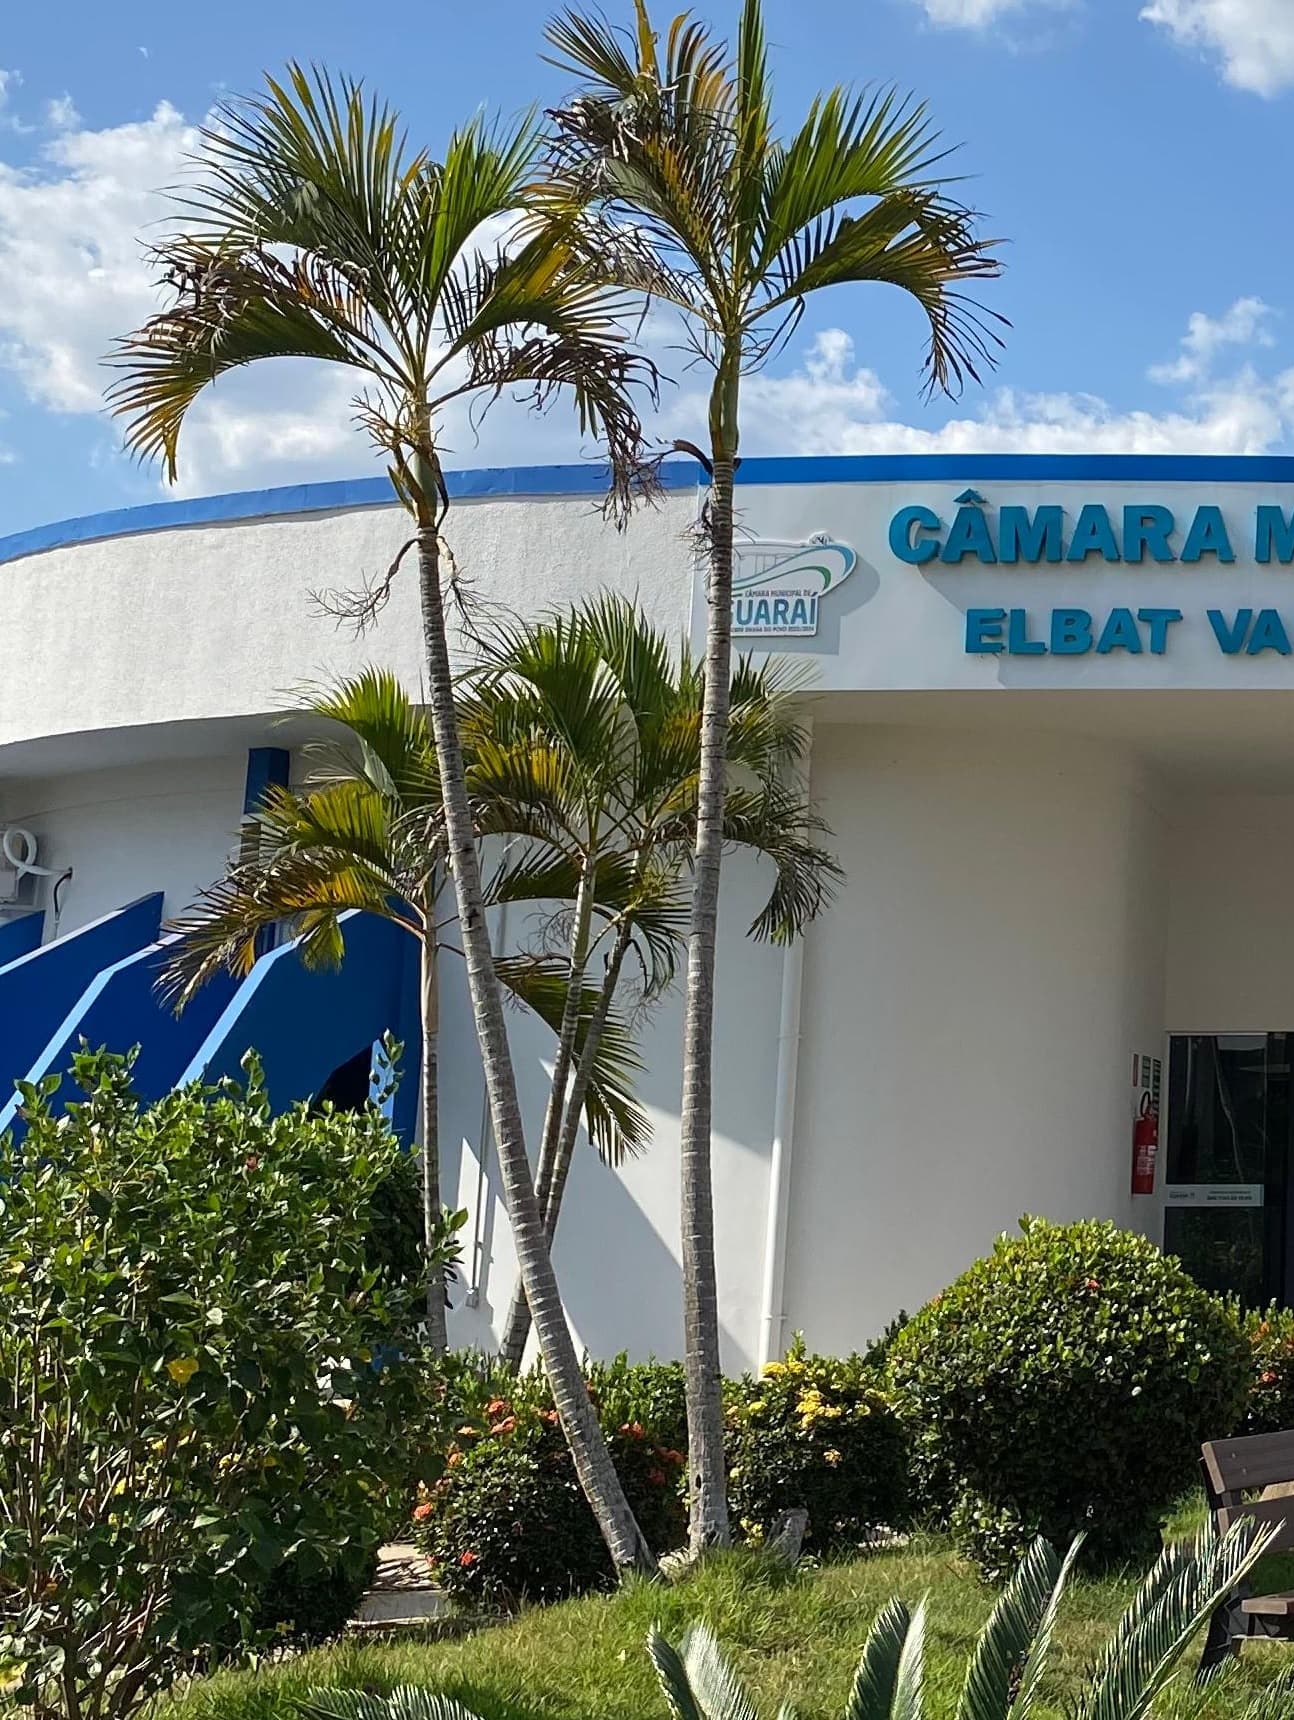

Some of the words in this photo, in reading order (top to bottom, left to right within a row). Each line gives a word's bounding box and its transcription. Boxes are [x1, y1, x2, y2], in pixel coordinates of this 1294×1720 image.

[888, 488, 1236, 564] CÂMARA
[735, 592, 818, 625] UARAÍ
[964, 607, 1184, 656] ELBAT
